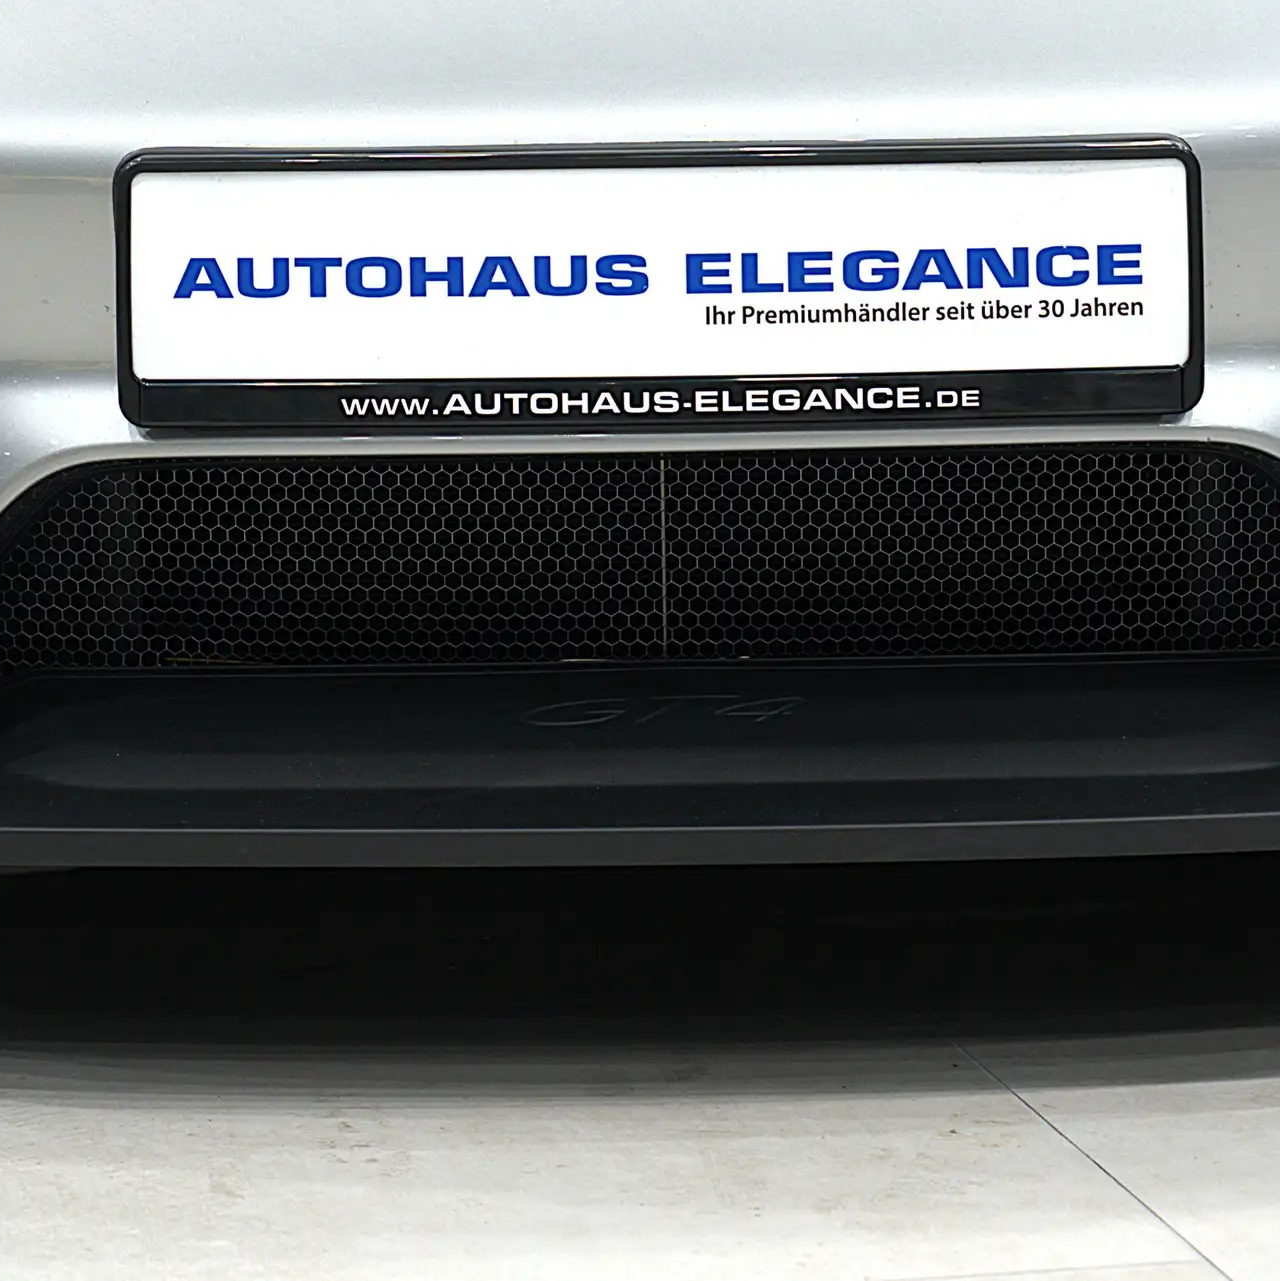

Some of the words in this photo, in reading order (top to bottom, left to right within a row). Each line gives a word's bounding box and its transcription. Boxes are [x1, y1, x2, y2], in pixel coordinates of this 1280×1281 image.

[173, 253, 649, 300] AUTOHAUS
[685, 243, 1143, 295] ELEGANCE
[705, 305, 736, 325] Ihr
[742, 301, 930, 325] Premiumhändler
[935, 302, 975, 321] seit
[981, 299, 1033, 320] über
[1038, 299, 1065, 318] 30
[1069, 297, 1144, 320] Jahren
[521, 693, 806, 728] GT4
